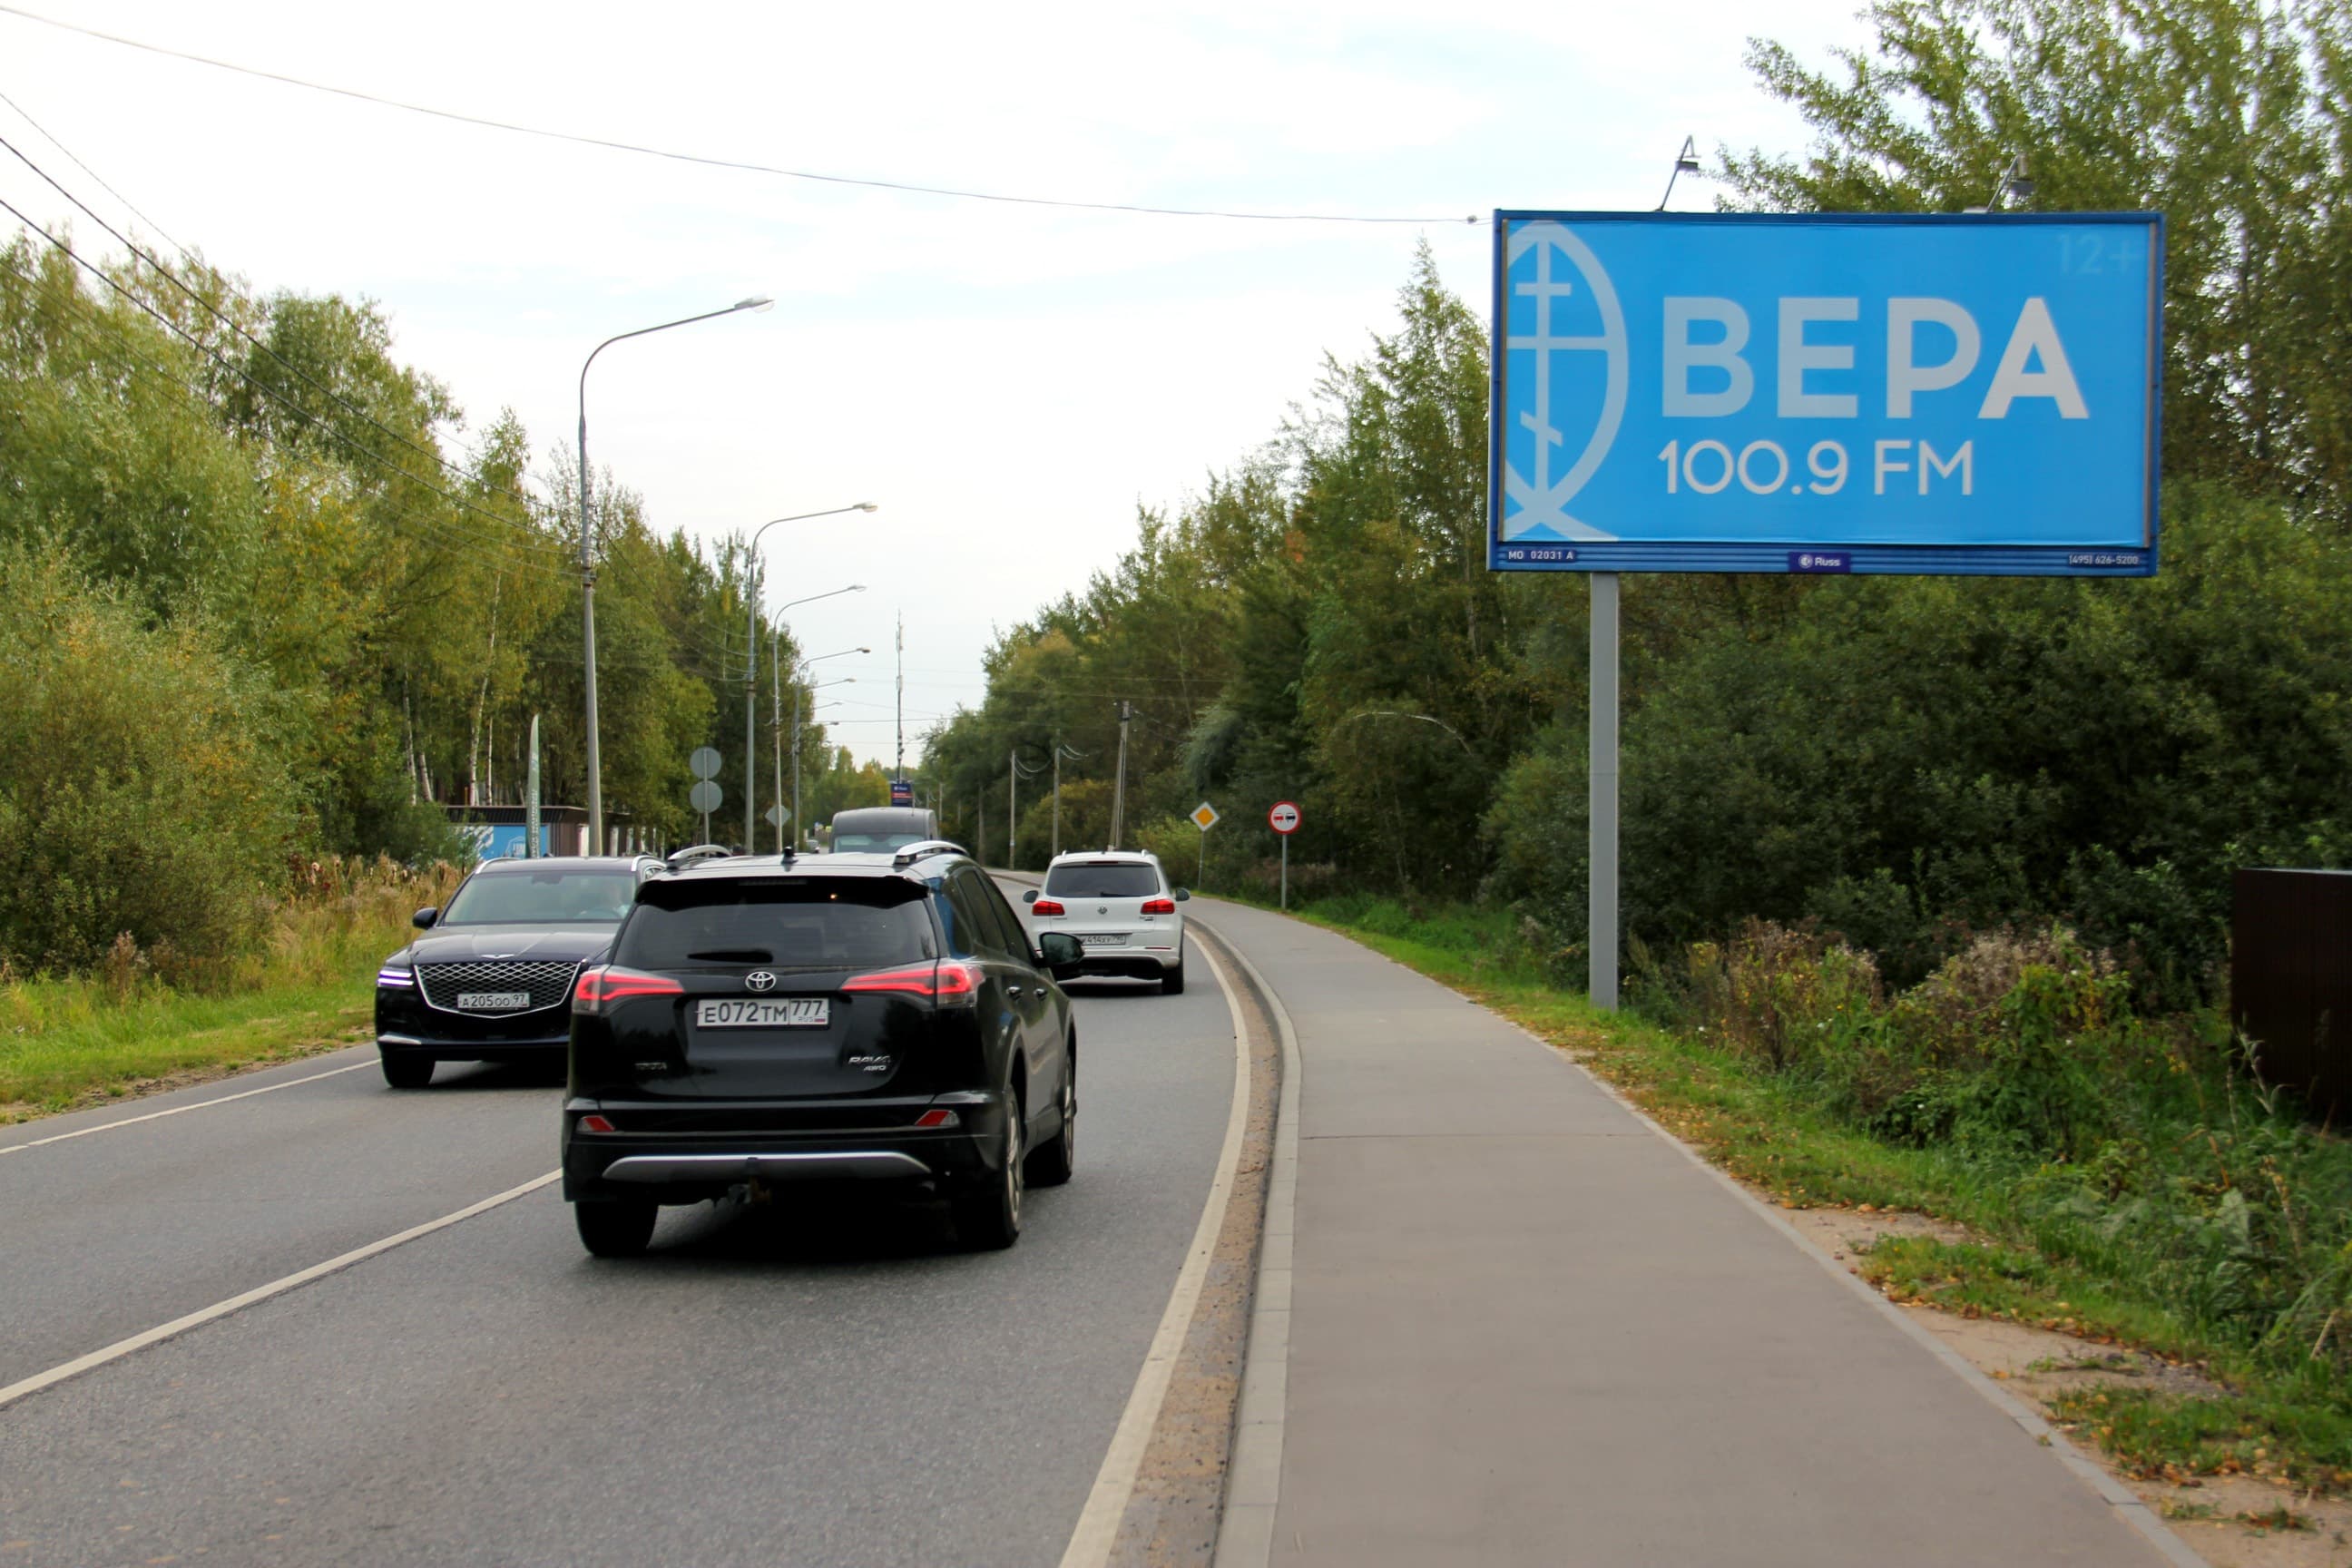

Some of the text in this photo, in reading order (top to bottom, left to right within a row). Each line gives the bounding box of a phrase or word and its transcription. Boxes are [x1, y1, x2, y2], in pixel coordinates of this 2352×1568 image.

[1662, 297, 2088, 418] ВЕРА
[1658, 440, 1974, 495] 100.9 FM
[1530, 551, 1562, 560] 02031
[1814, 557, 1841, 567] Russ
[790, 1000, 823, 1016] 777
